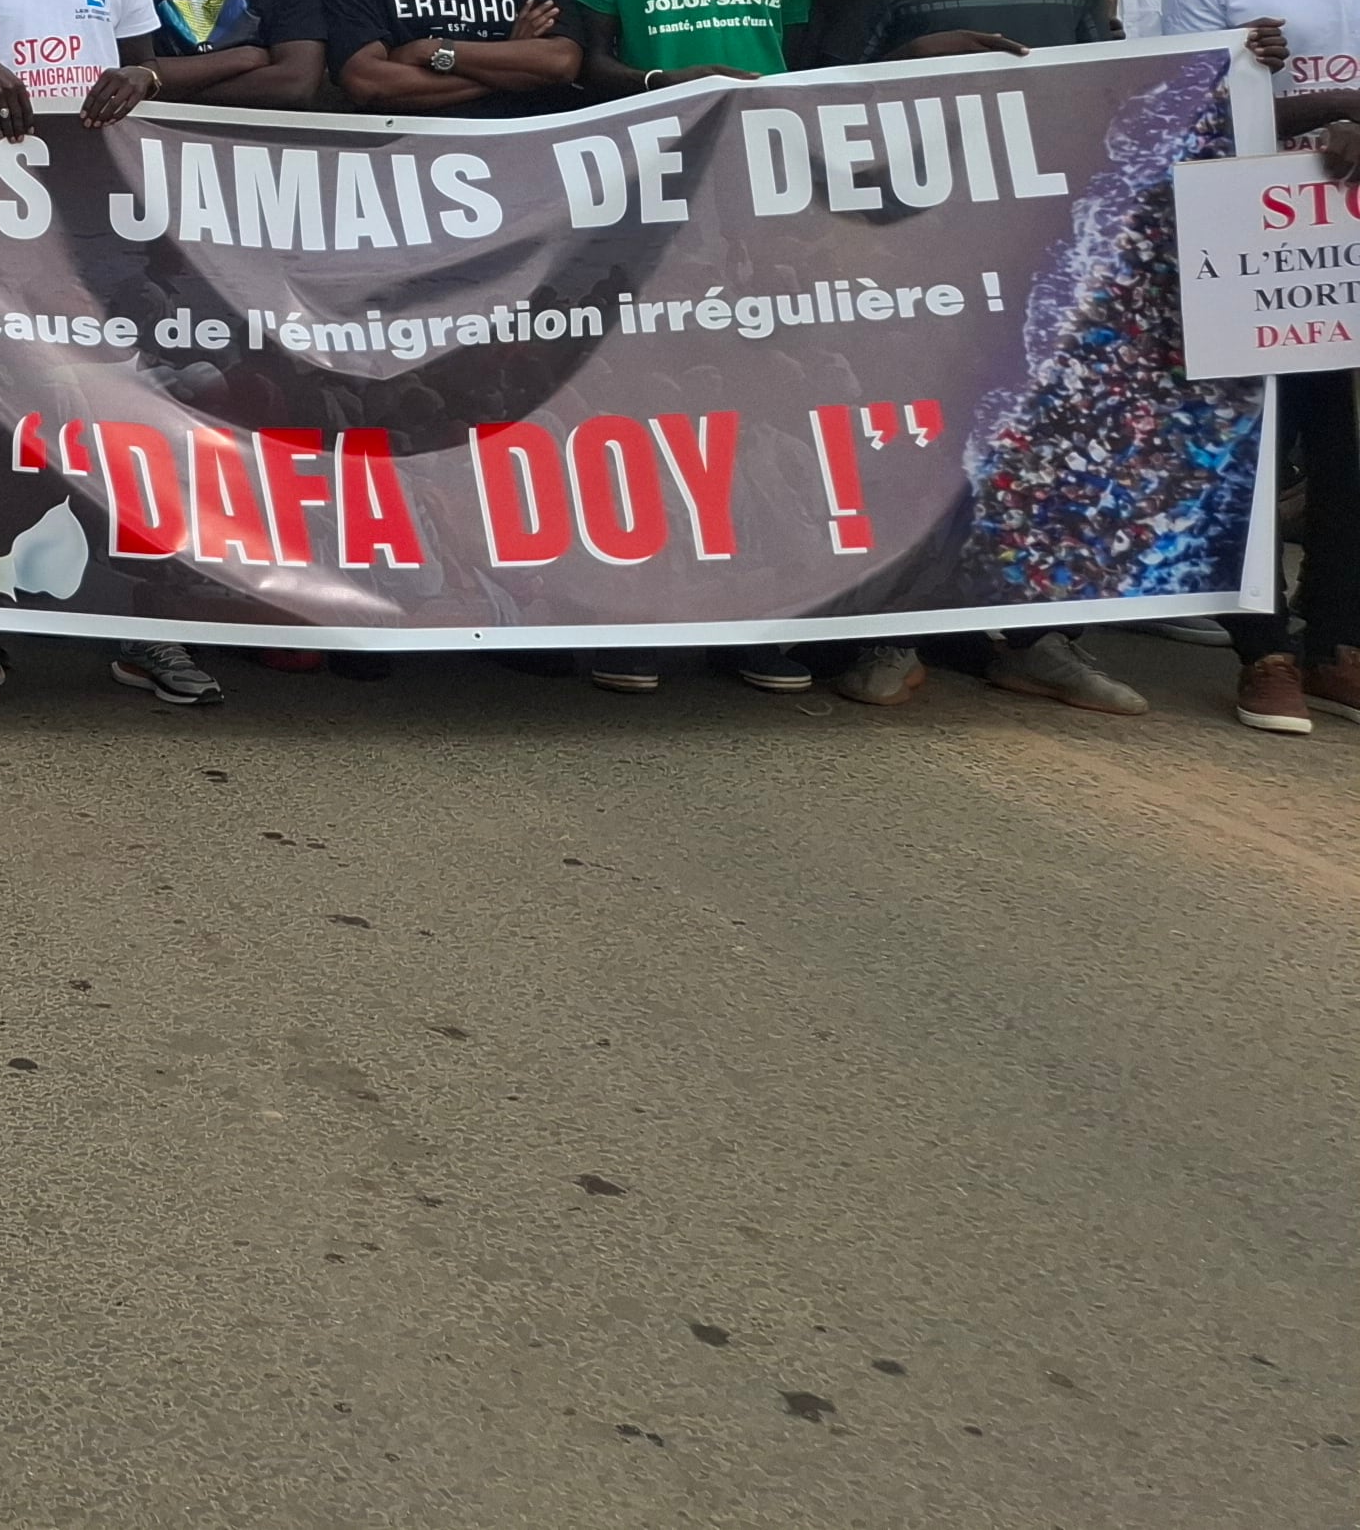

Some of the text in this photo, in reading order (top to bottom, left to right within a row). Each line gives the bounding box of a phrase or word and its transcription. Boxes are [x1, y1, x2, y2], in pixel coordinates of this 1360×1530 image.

[696, 19, 711, 29] au
[713, 16, 740, 27] bout
[14, 35, 81, 65] STOP
[108, 137, 504, 251] JAMAIS
[552, 115, 690, 229] DE
[741, 90, 1068, 217] DEUIL
[1196, 249, 1220, 280] À
[155, 308, 231, 350] de
[249, 299, 603, 360] l'émigration
[619, 277, 965, 339] irrégulière
[981, 271, 1005, 313] !
[1253, 320, 1353, 349] DAFA
[469, 410, 741, 569] DOY
